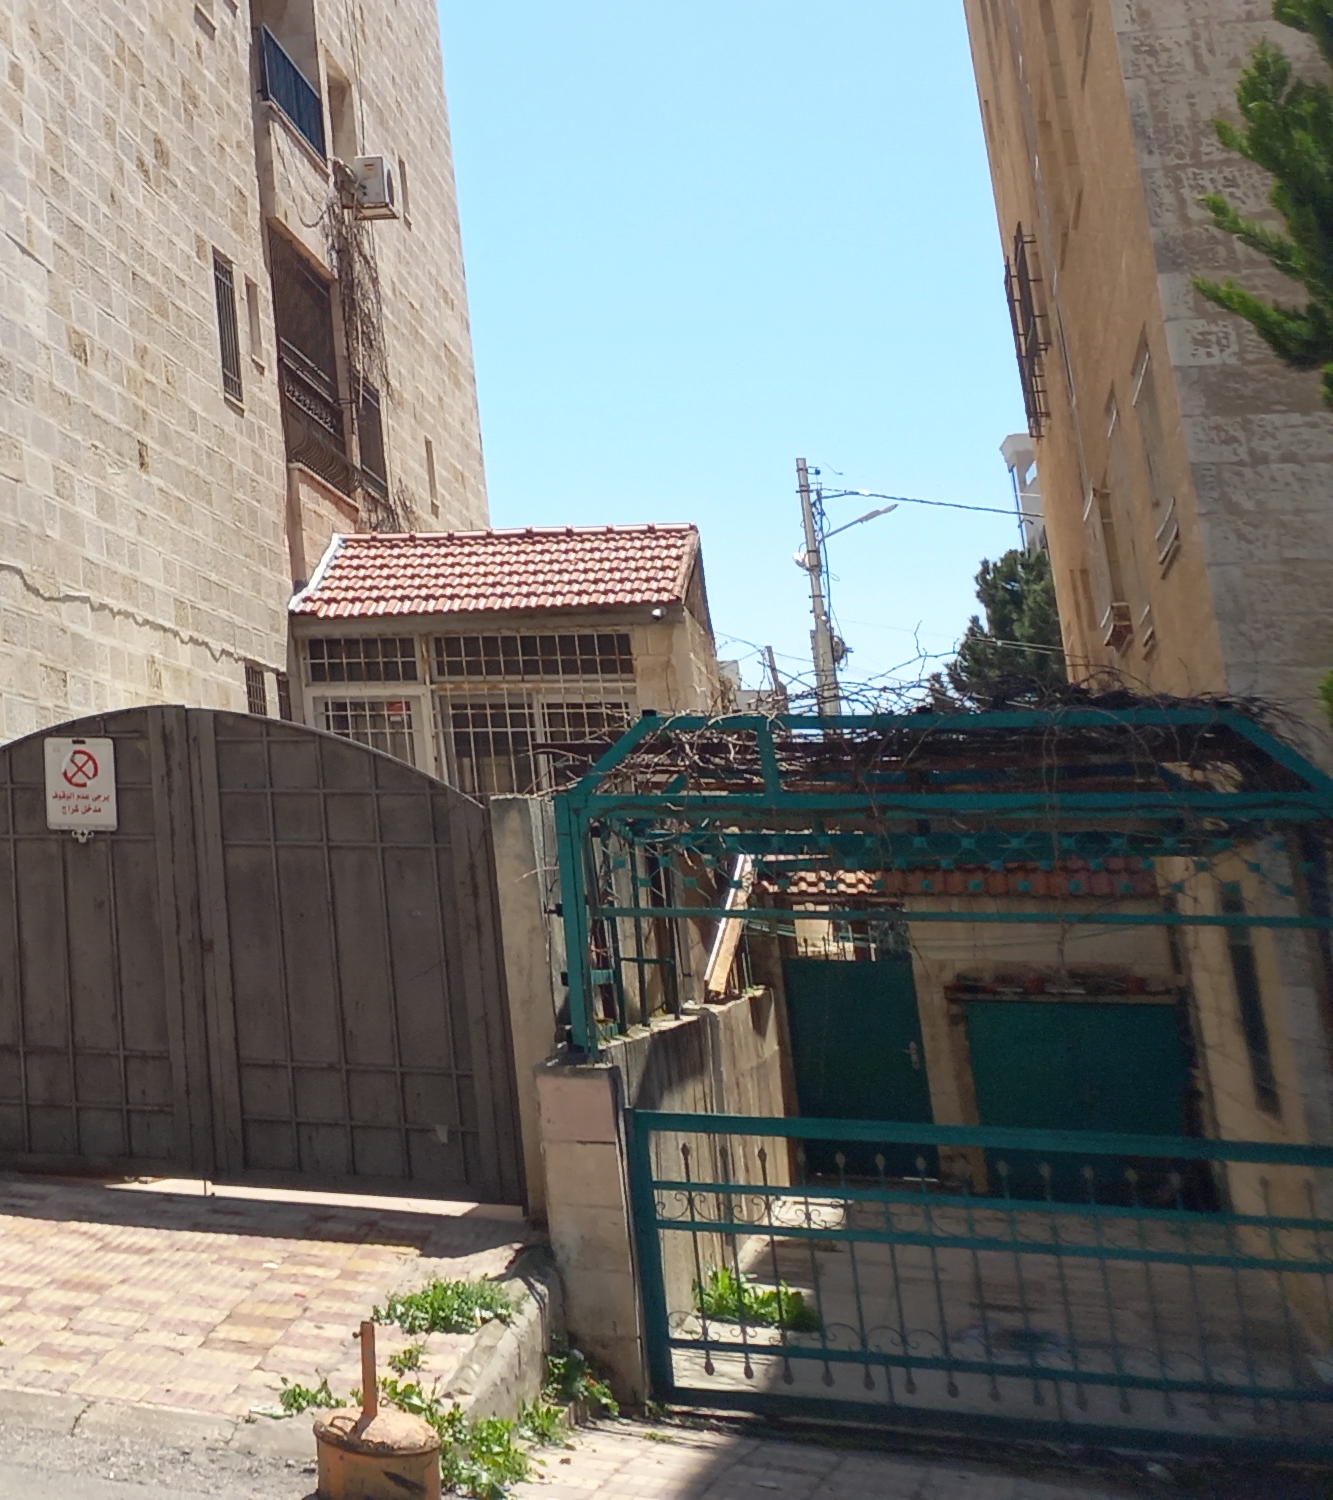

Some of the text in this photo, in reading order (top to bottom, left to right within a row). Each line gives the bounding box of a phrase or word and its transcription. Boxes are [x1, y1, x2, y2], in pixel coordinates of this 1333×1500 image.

[52, 790, 74, 801] الوقوف
[77, 793, 90, 801] عدم
[81, 803, 102, 815] مدخل
